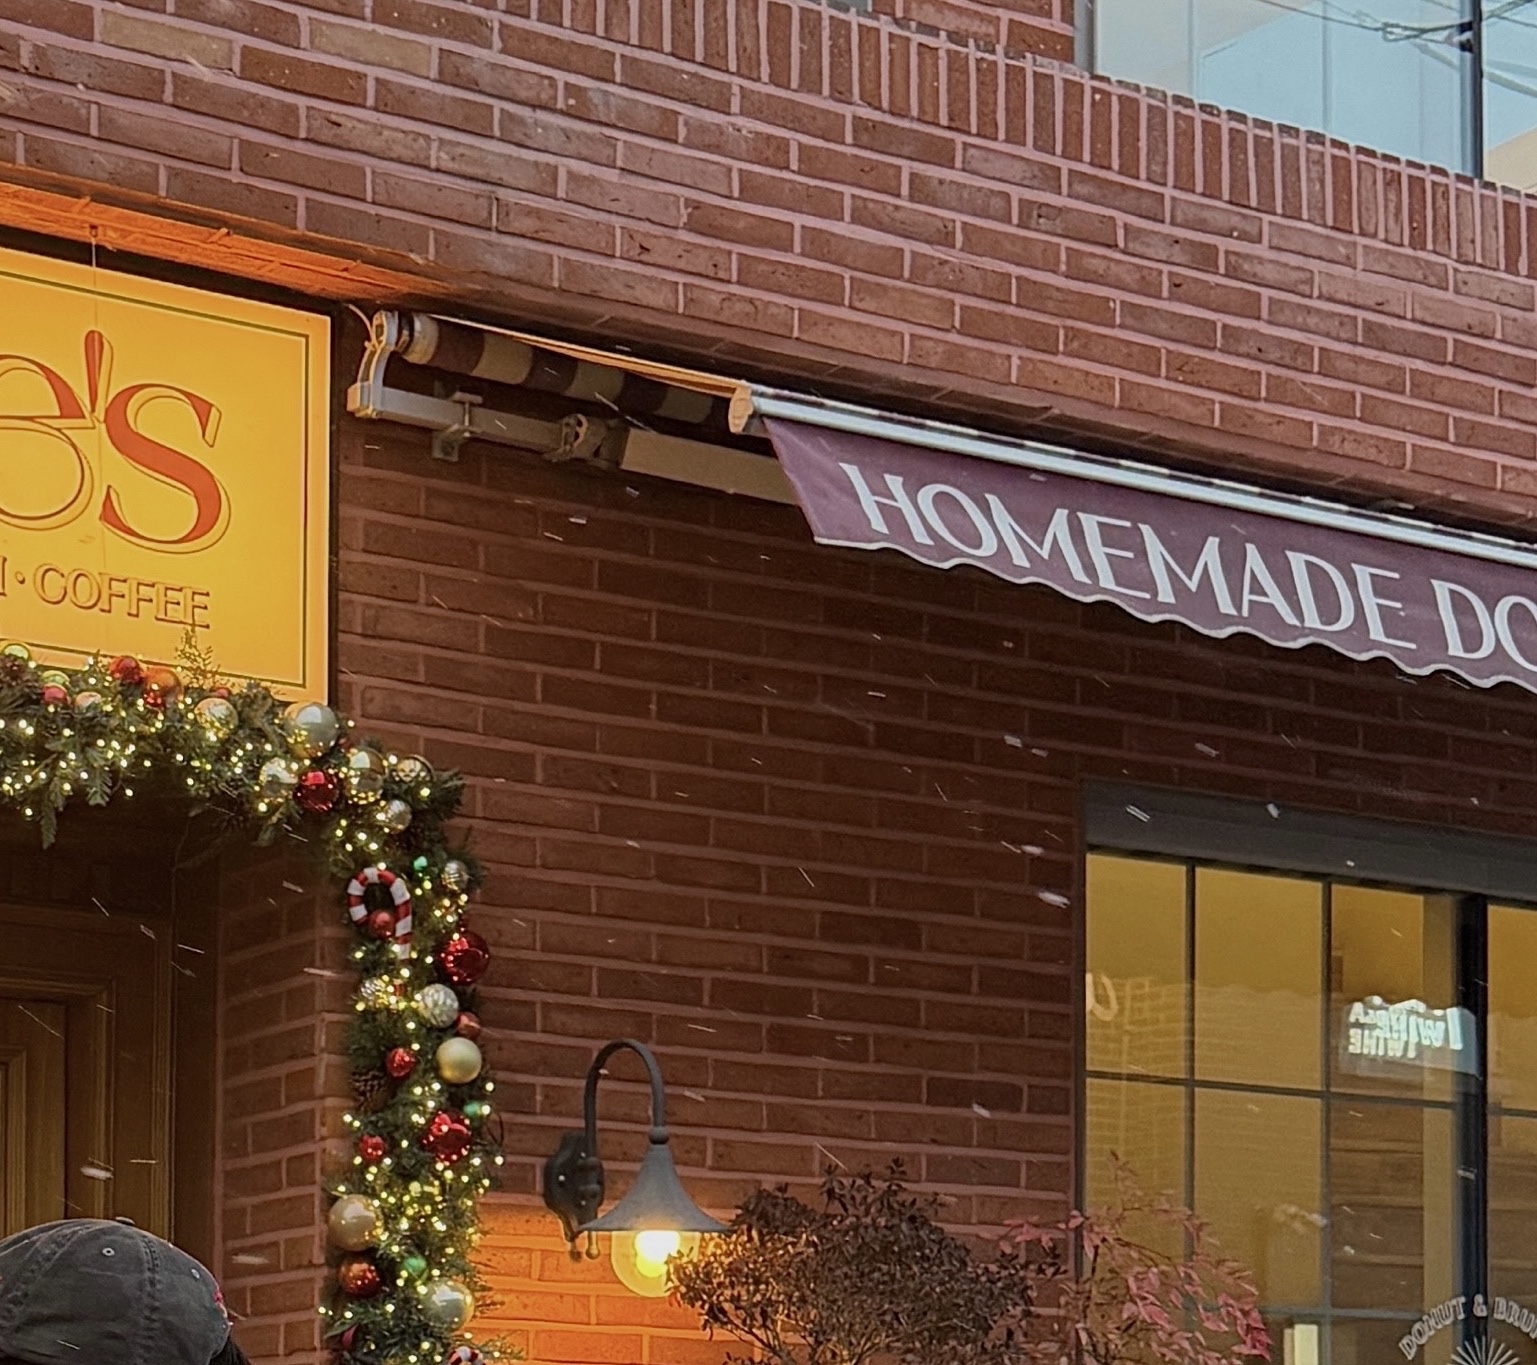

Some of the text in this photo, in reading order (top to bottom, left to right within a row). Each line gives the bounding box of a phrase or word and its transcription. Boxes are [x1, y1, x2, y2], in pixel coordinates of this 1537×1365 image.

[33, 563, 211, 628] COFFEE
[839, 462, 1537, 673] HOMEMADE DO
[1398, 1296, 1467, 1360] DONUT
[1473, 1294, 1488, 1317] &
